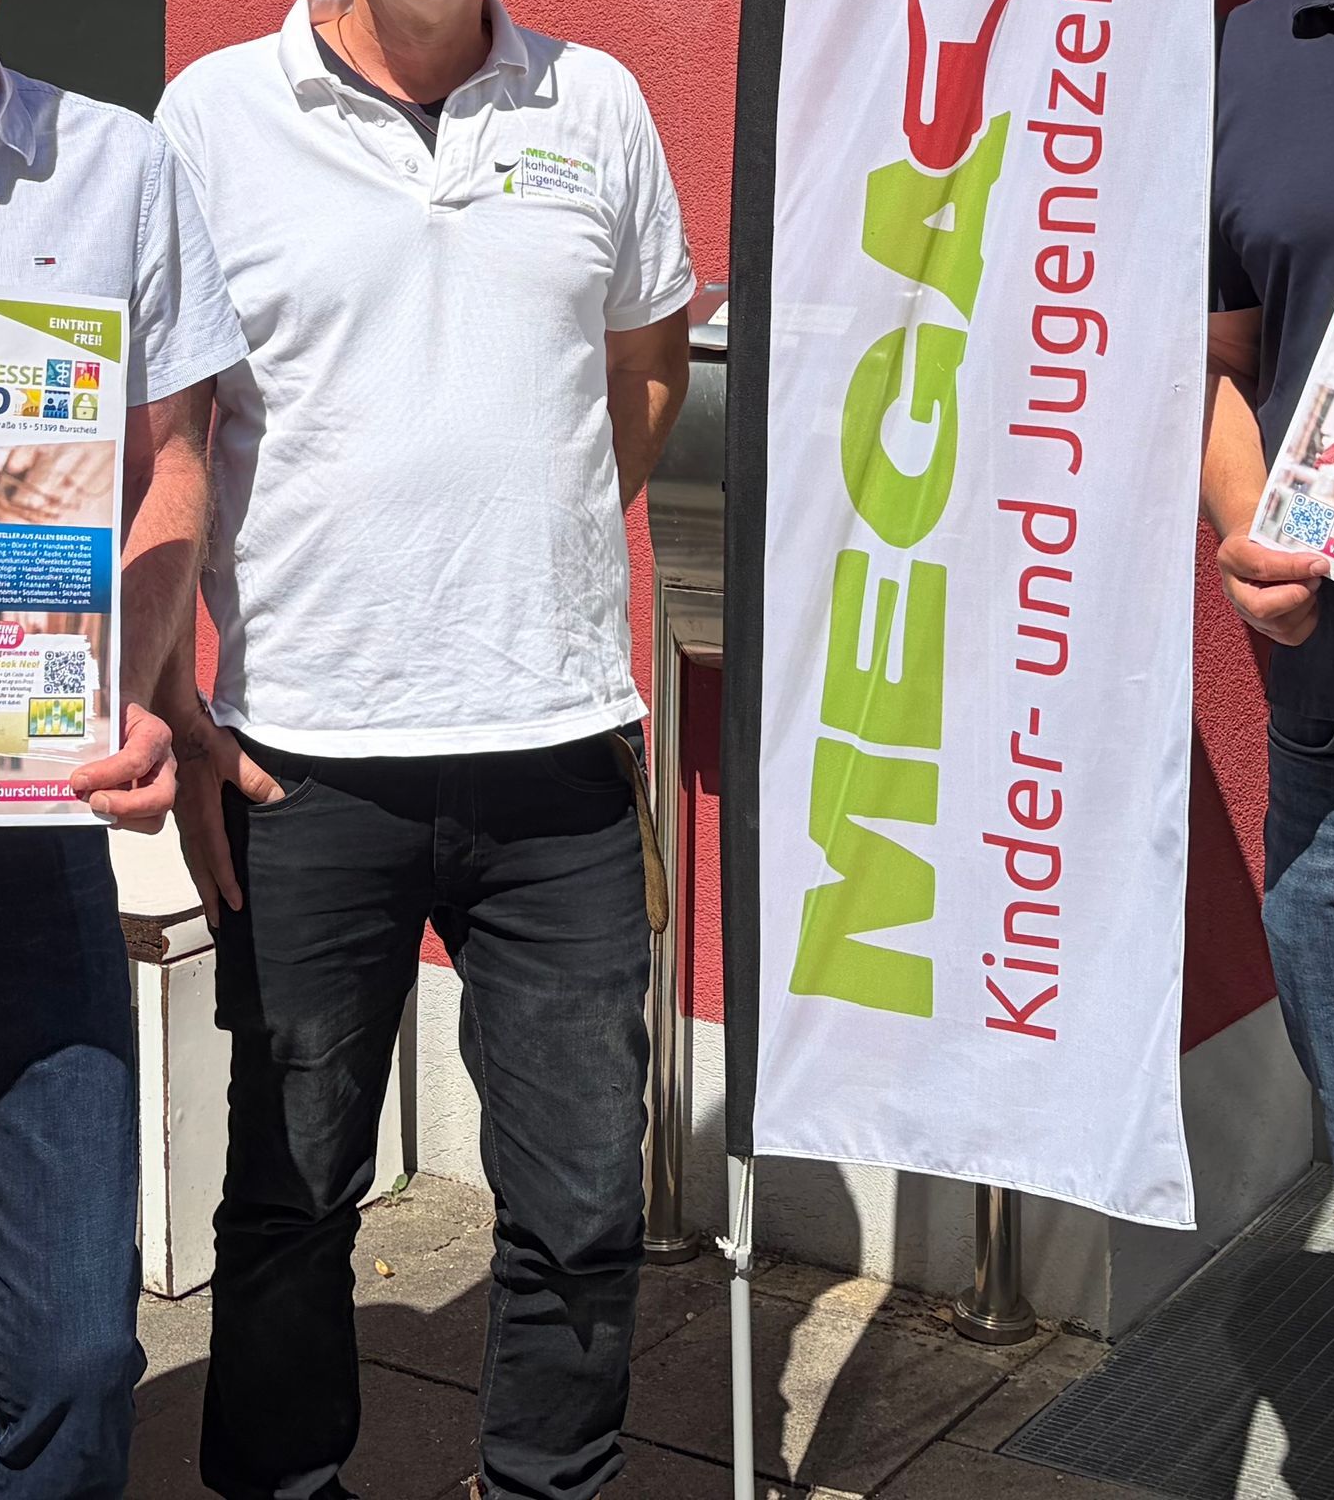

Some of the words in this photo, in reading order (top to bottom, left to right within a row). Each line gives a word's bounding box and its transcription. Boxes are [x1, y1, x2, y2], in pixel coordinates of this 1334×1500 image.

[525, 157, 579, 180] katholische
[49, 317, 102, 332] EINTRITT
[73, 333, 101, 345] FREI!
[998, 499, 1077, 676] und
[982, 708, 1064, 1041] Kinder-
